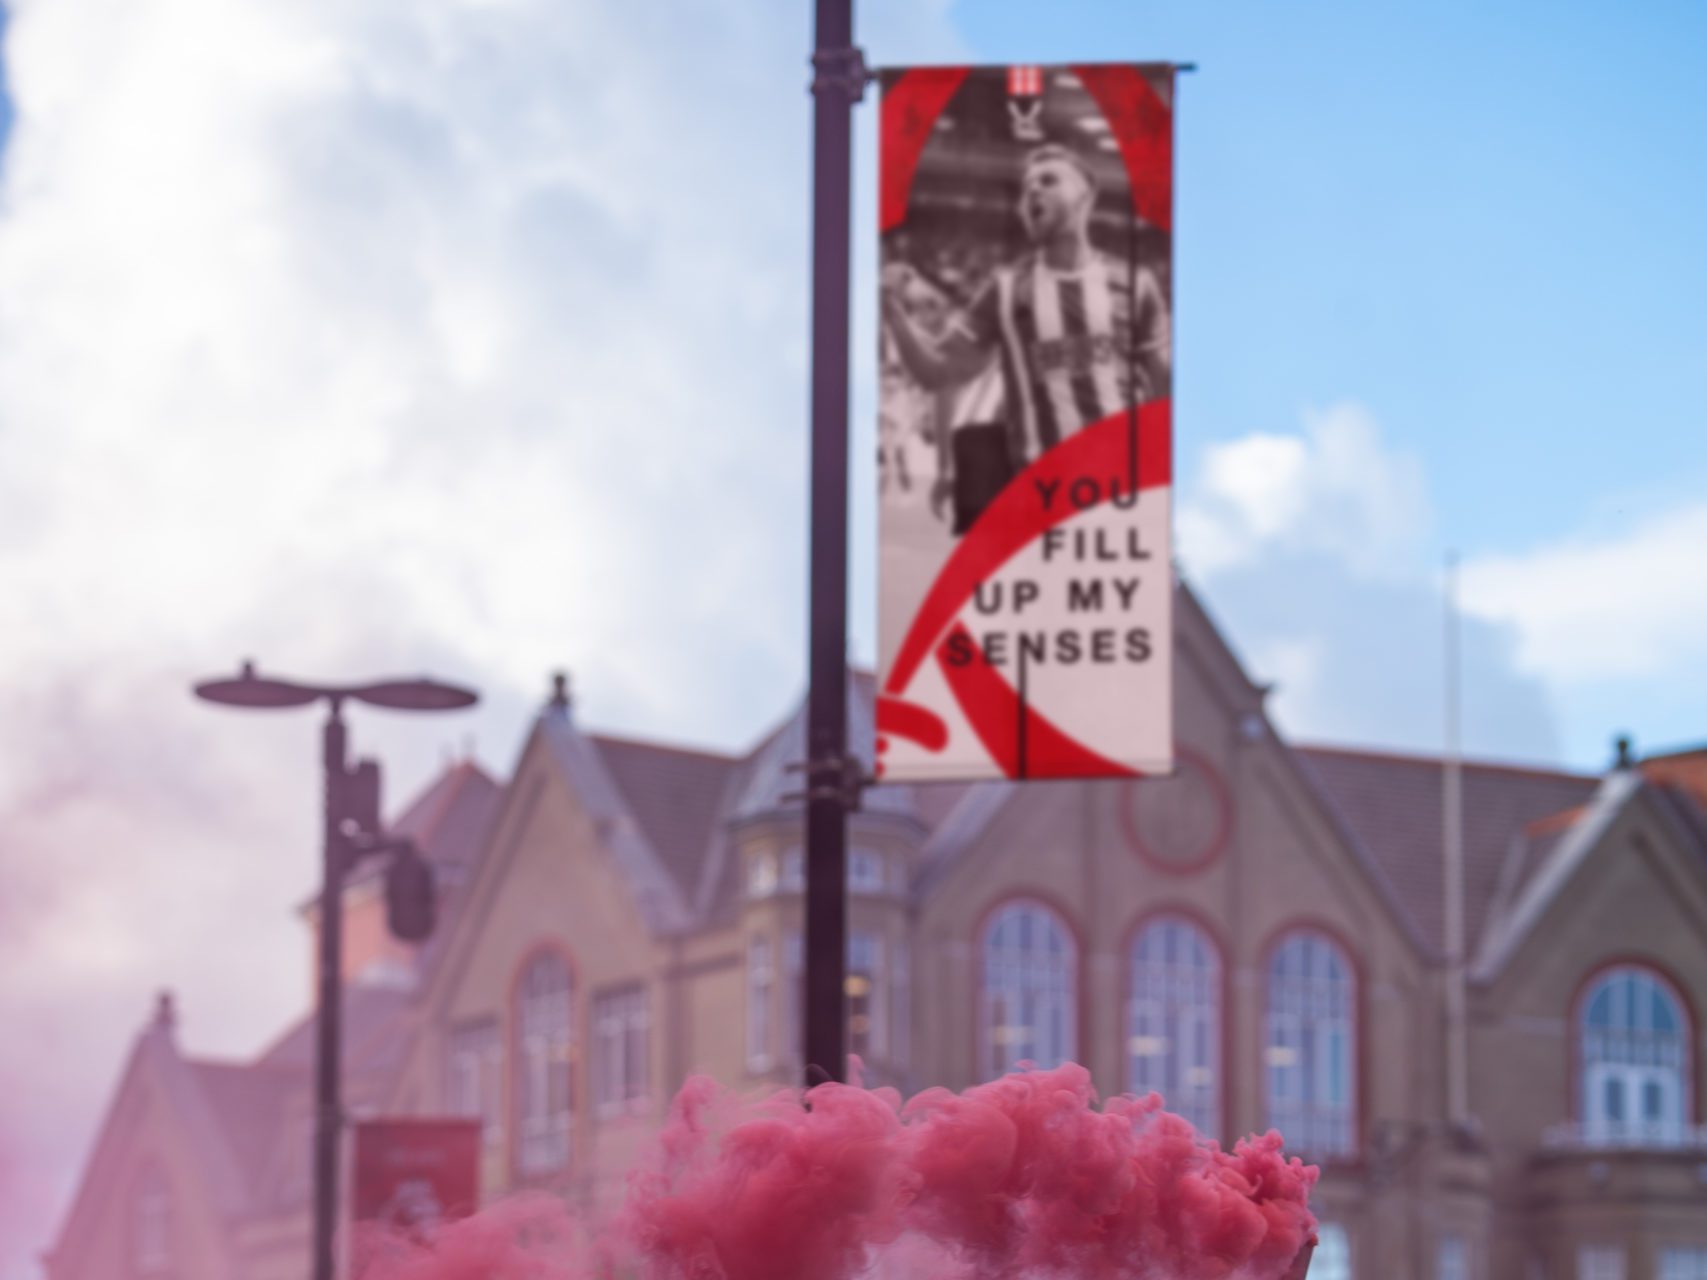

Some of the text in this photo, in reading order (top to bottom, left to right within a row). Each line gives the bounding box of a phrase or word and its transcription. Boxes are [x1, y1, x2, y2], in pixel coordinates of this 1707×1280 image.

[1036, 478, 1139, 509] YOU
[1043, 528, 1151, 561] FILL
[974, 579, 1140, 614] UP MY
[948, 629, 1152, 666] SENSES
